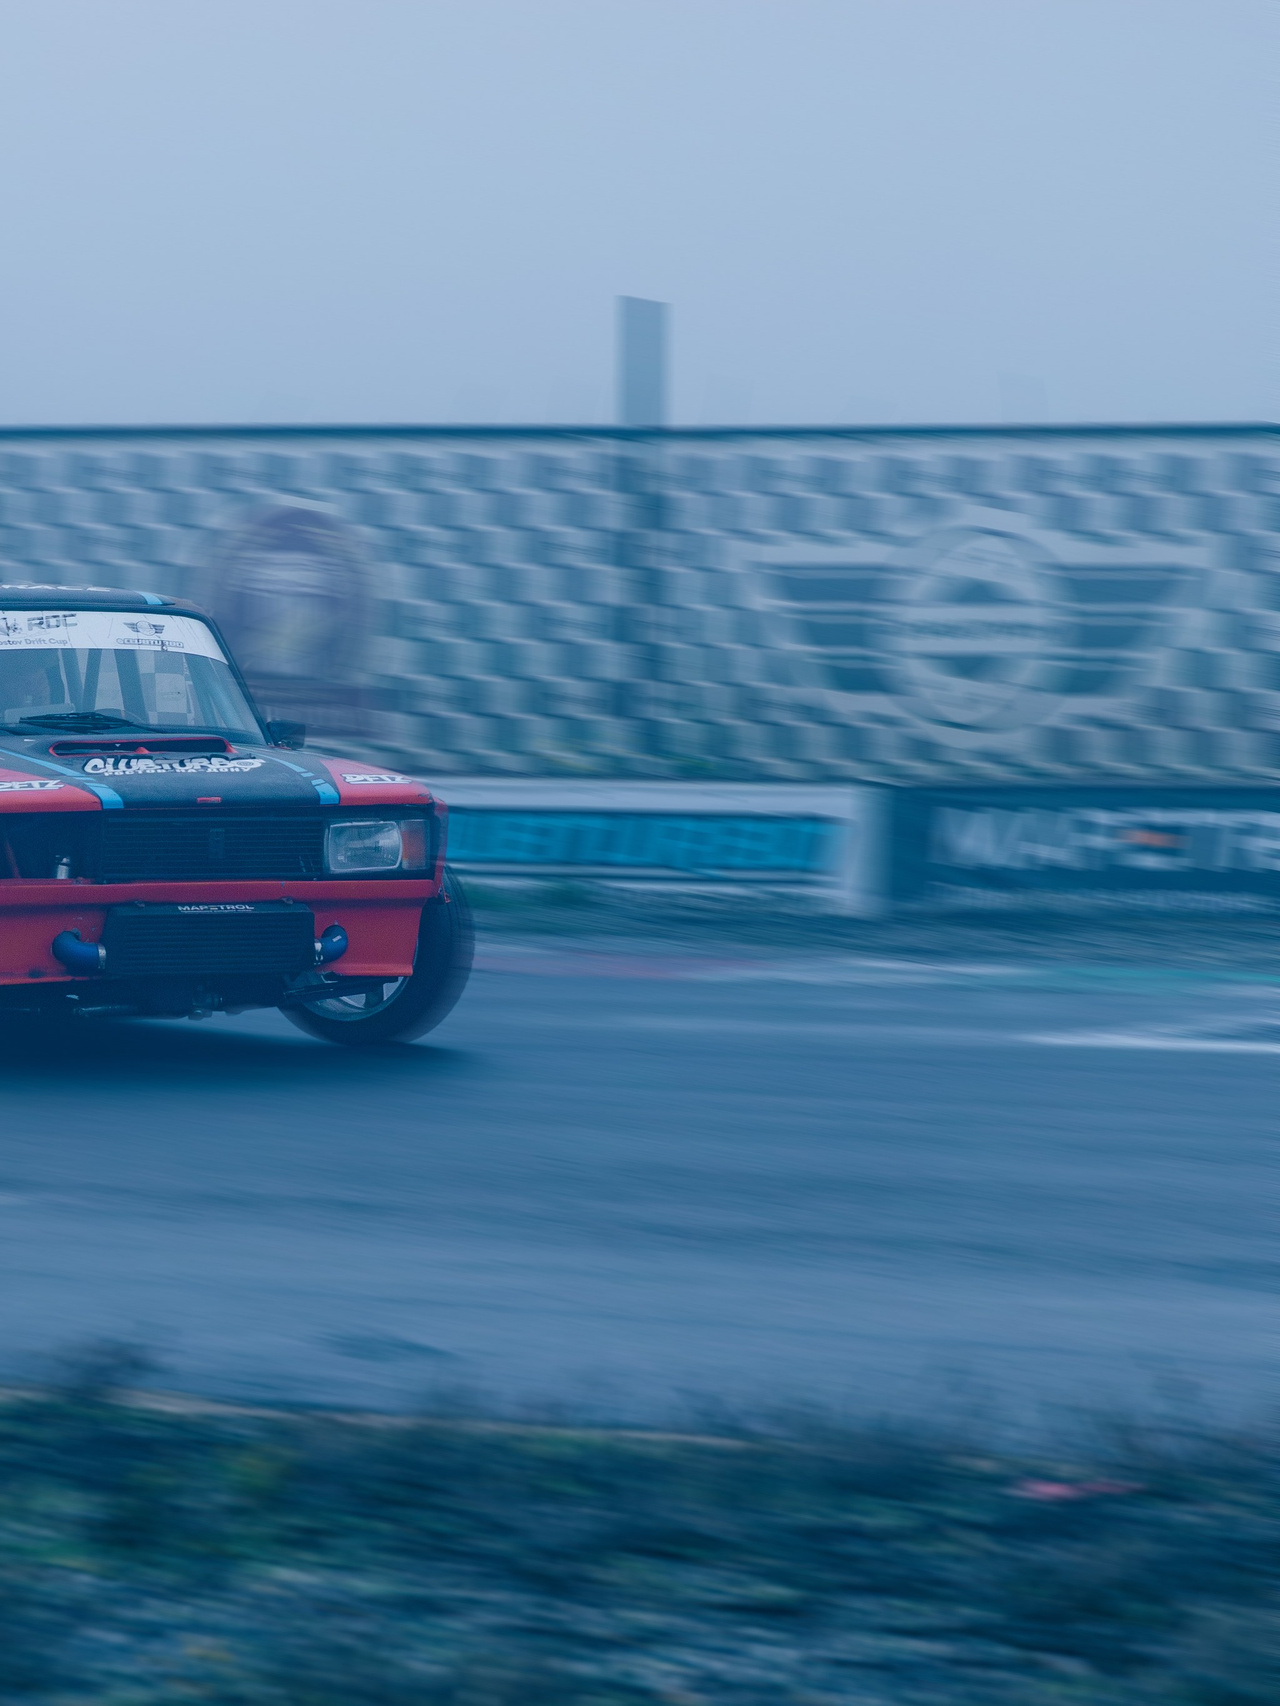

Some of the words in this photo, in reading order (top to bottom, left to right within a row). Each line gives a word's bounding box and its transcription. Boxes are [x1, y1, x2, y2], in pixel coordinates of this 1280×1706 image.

[24, 637, 46, 646] Drift
[48, 638, 69, 646] Cup
[84, 757, 266, 774] CLUBTURBO
